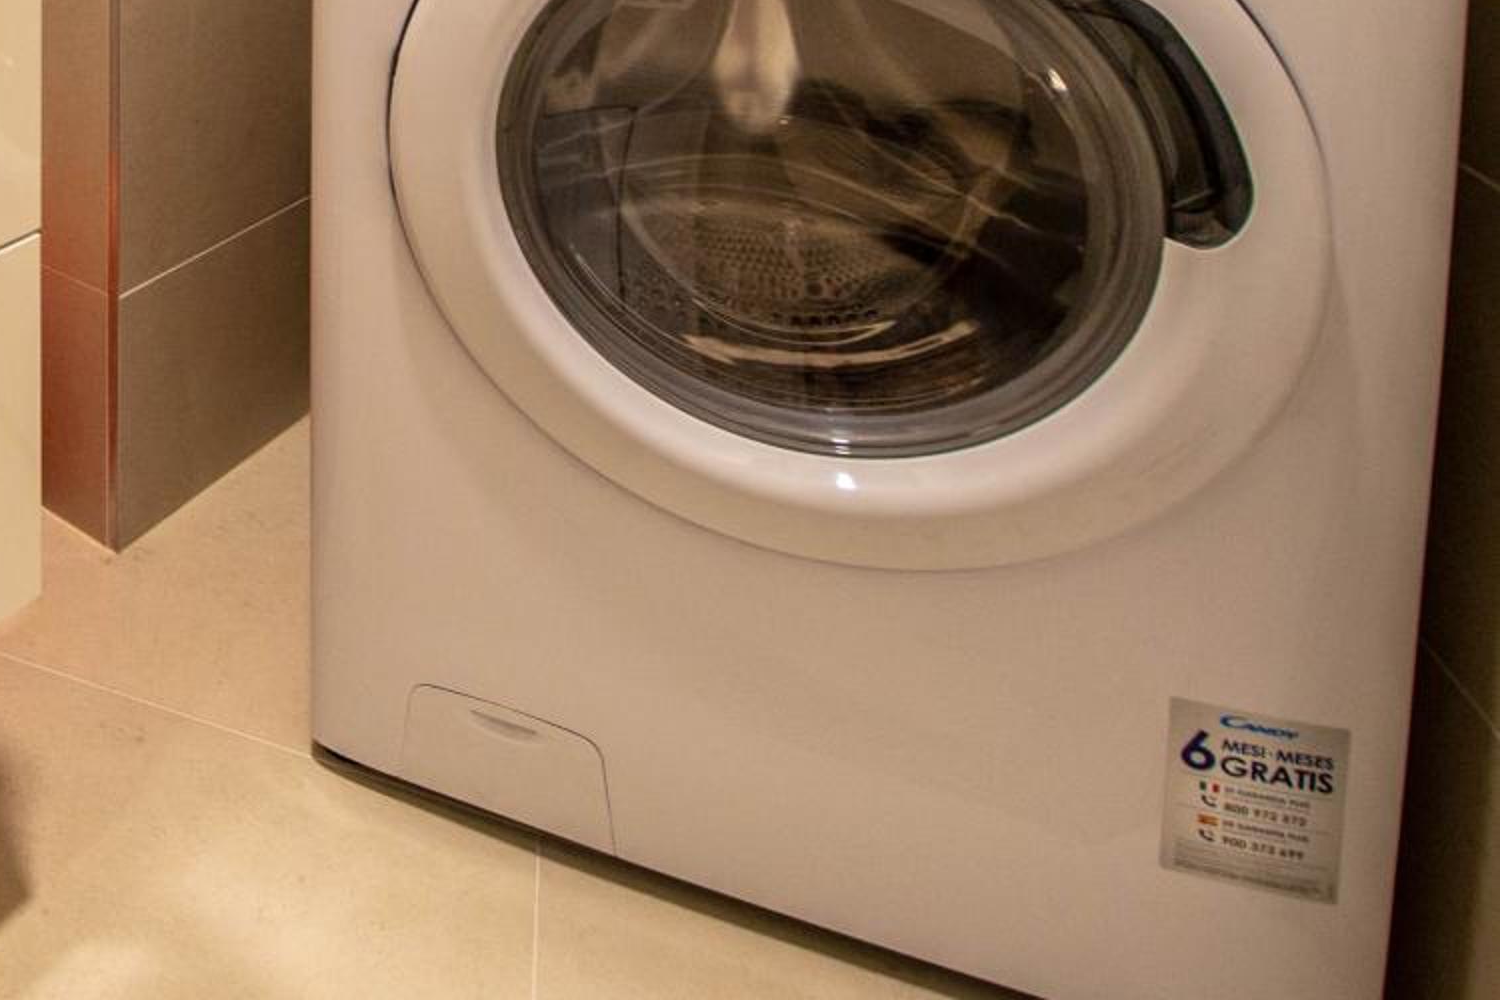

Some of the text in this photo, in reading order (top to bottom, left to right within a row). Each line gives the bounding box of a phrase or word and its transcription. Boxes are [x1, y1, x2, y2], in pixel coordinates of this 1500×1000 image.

[1181, 729, 1216, 771] 6
[1221, 738, 1334, 771] MESI MESES
[1221, 756, 1333, 794] GRATIS
